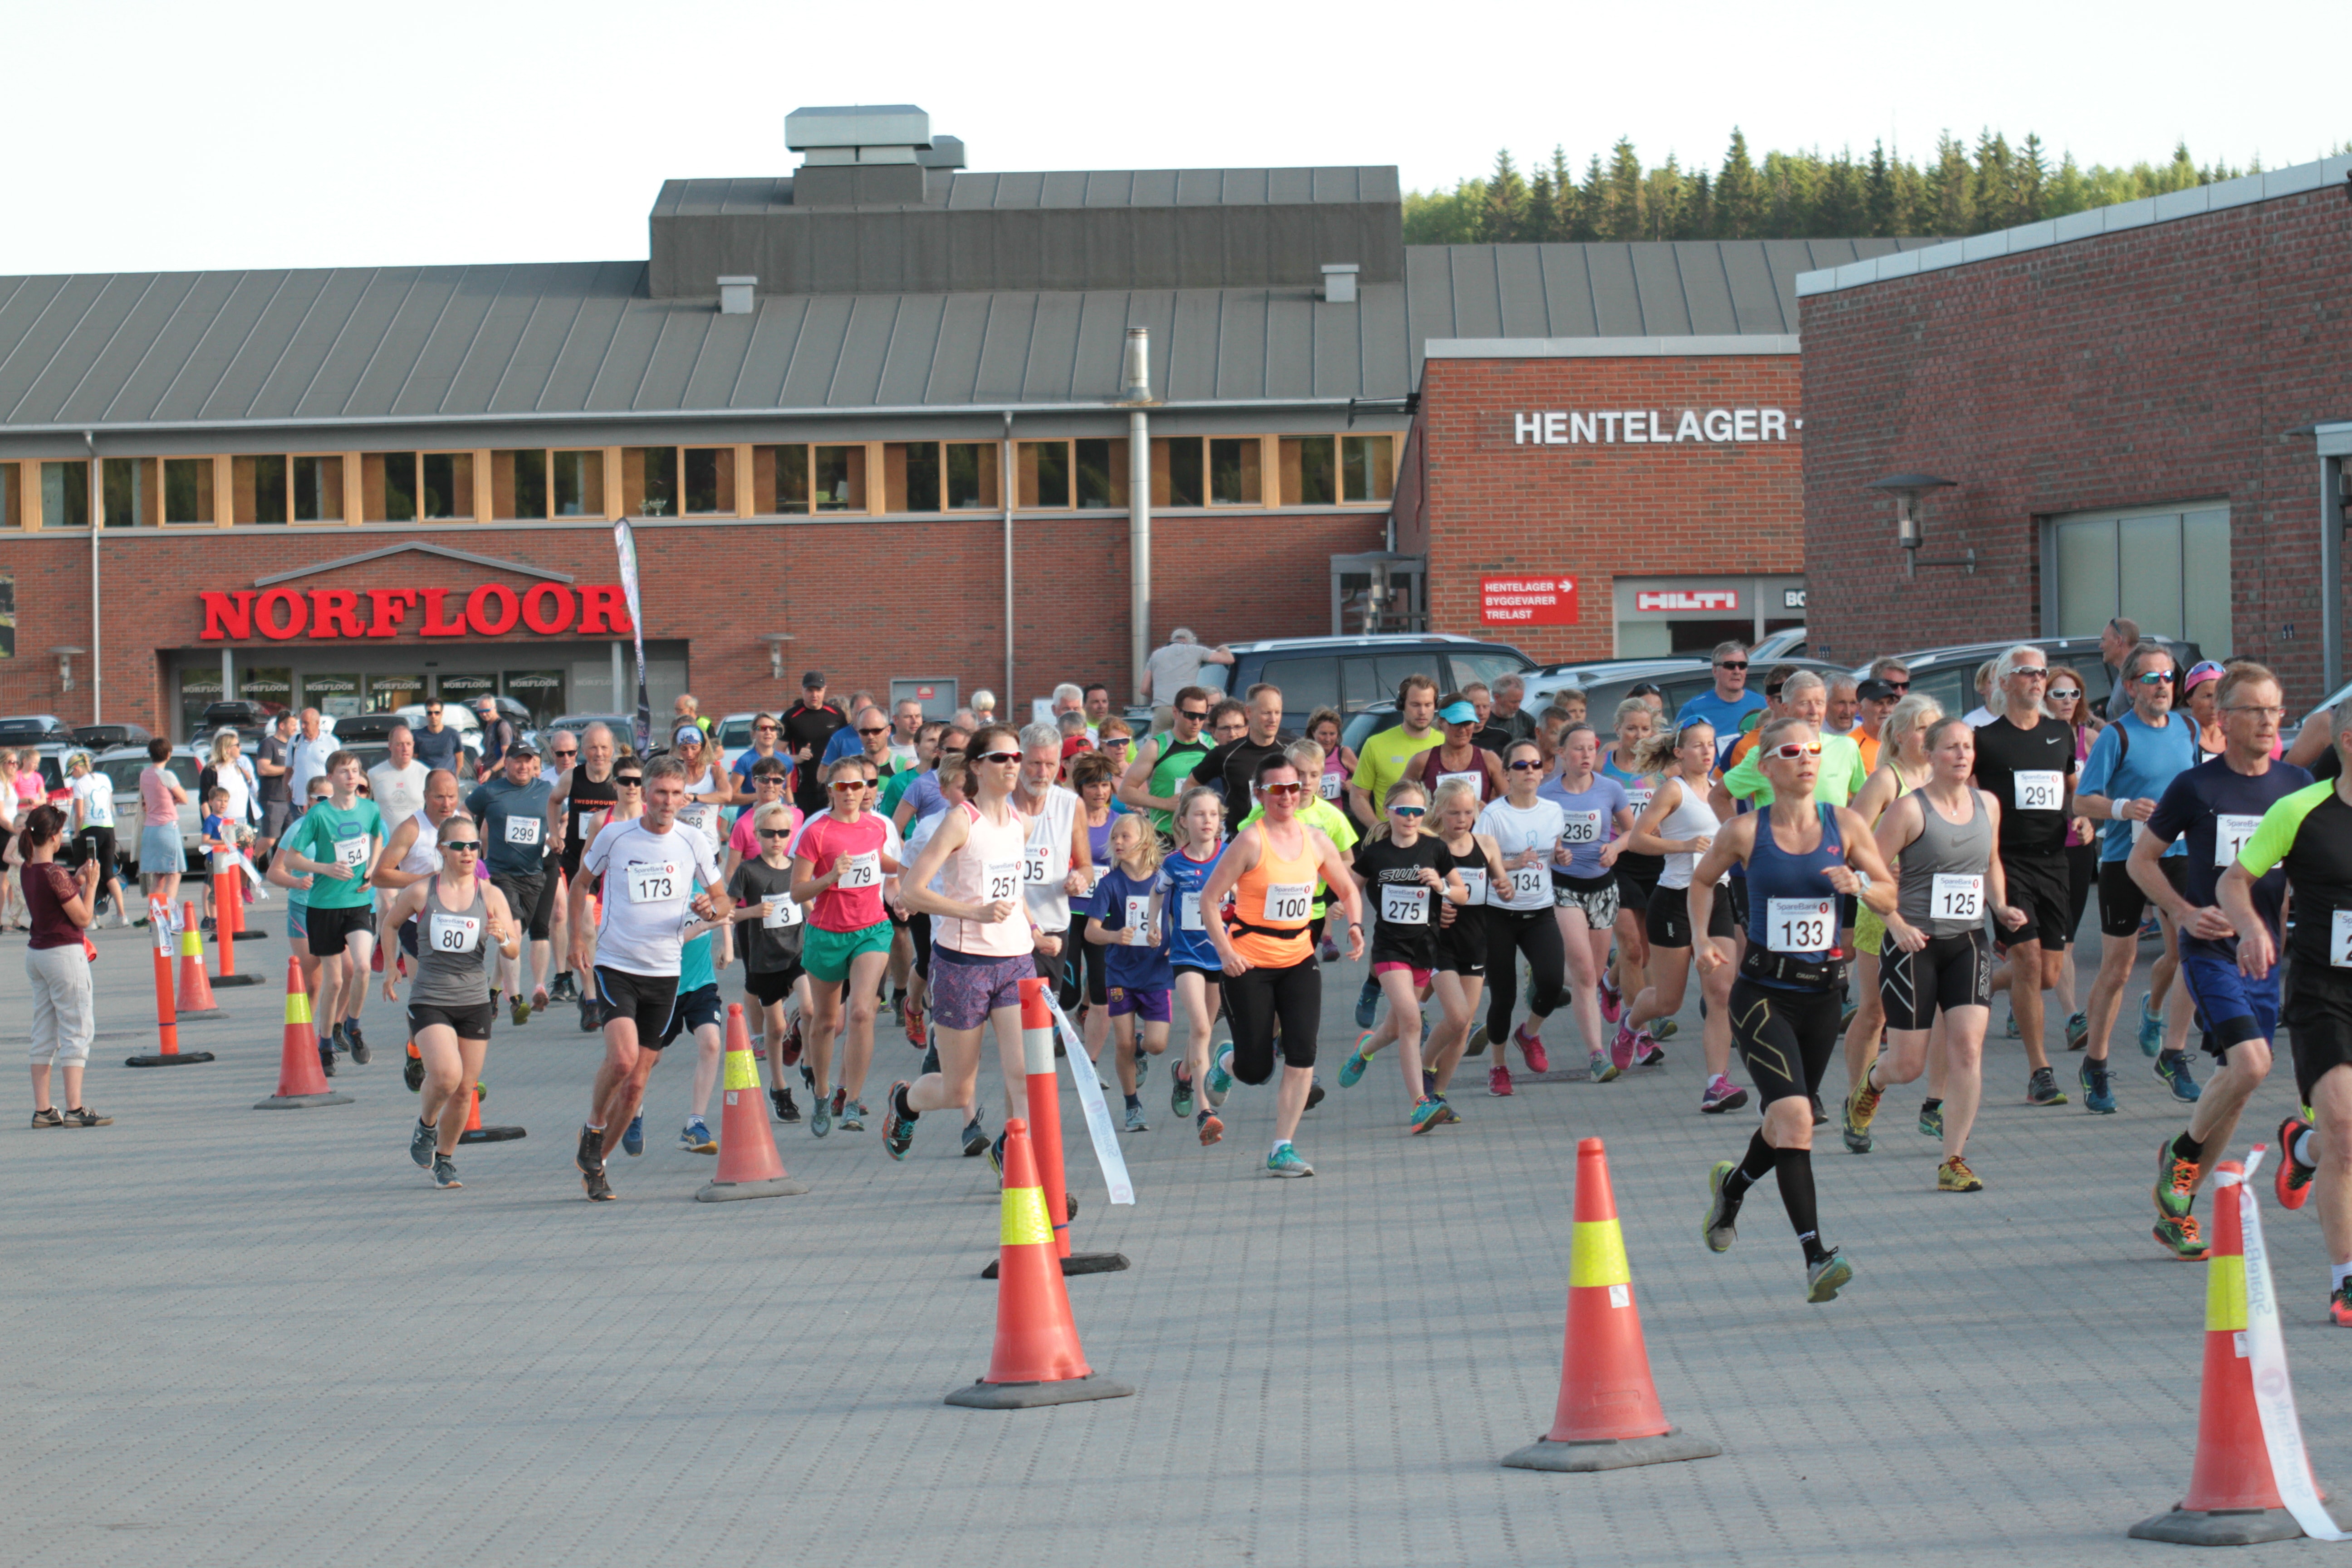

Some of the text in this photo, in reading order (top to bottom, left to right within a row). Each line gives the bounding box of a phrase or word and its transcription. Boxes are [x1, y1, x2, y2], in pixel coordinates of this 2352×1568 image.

[1515, 409, 1787, 445] HENTELAGER
[1485, 583, 1554, 592] HENTELAGER
[1485, 596, 1556, 606] BYGGEVARER
[1639, 592, 1735, 609] HILTI
[200, 583, 633, 640] NORFLOOR
[1485, 610, 1532, 619] TRELAST
[372, 682, 422, 690] NORFLOOR
[2026, 786, 2054, 805] 291
[512, 827, 534, 842] 299
[1563, 823, 1592, 840] 236
[348, 848, 362, 864] 54
[853, 867, 871, 884] 79
[1513, 873, 1540, 891] 134
[639, 878, 672, 898] 173
[992, 876, 1016, 898] 251
[1276, 898, 1305, 918] 100
[1389, 901, 1420, 921] 275
[1776, 902, 1818, 911] SpareBank
[1944, 893, 1975, 915] 125
[781, 907, 789, 923] 3
[443, 930, 464, 950] 80
[1781, 920, 1823, 946] 133
